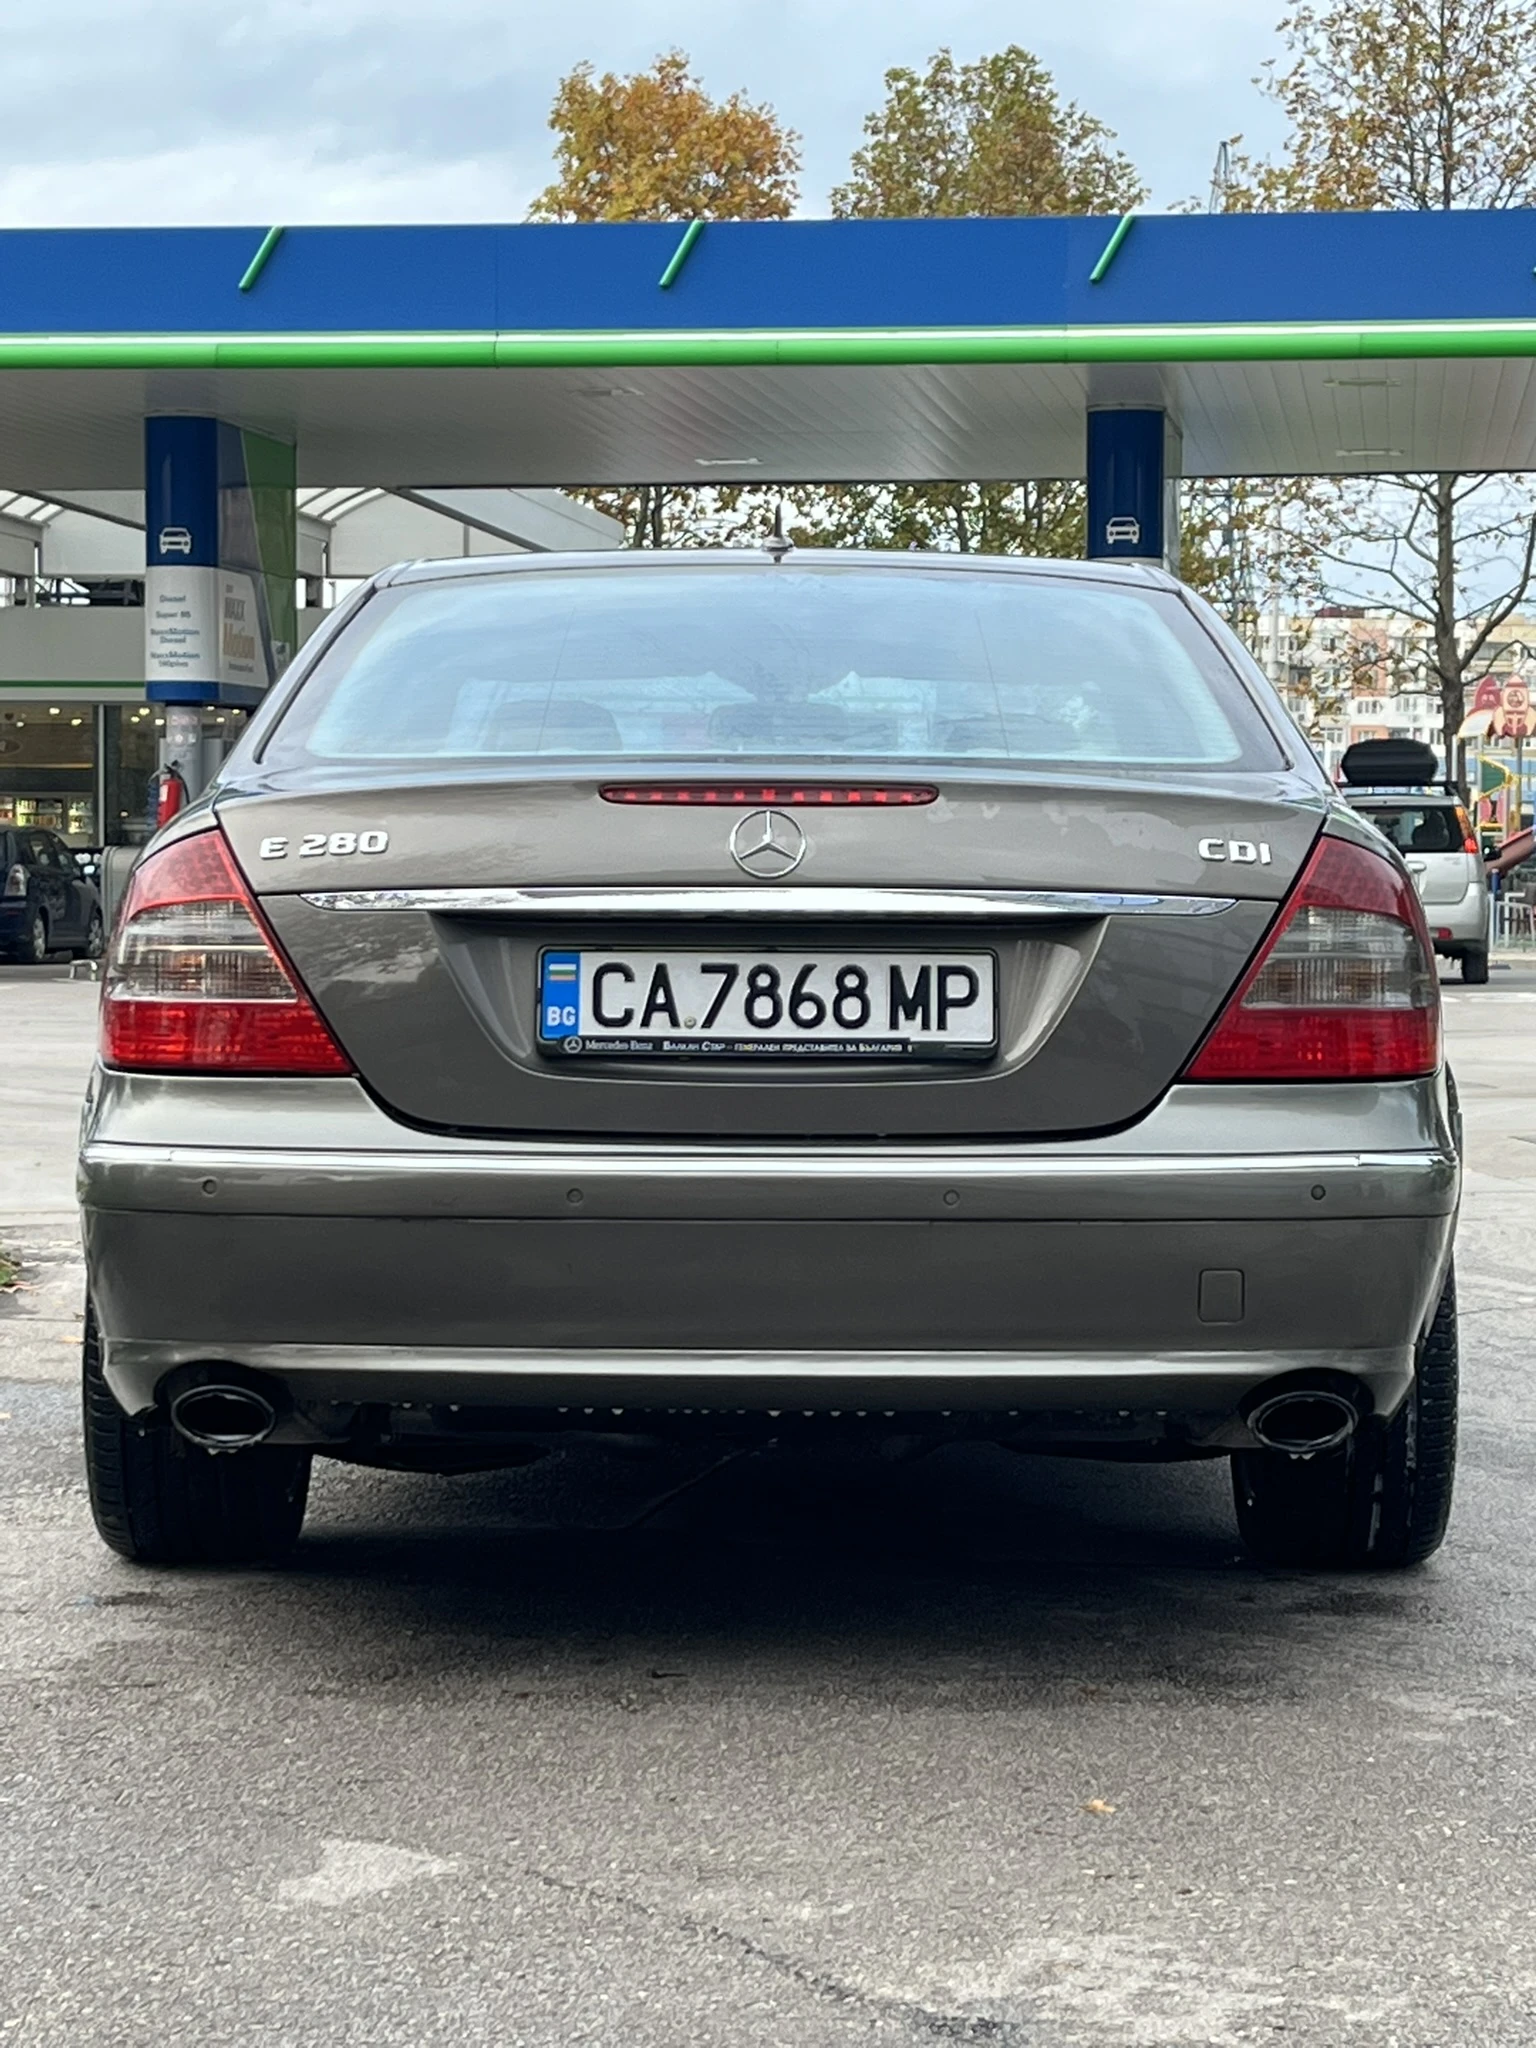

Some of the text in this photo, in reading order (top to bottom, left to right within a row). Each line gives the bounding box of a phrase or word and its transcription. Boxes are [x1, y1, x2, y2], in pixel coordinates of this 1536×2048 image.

[259, 831, 389, 860] E 280
[1198, 837, 1273, 865] CDI
[593, 962, 980, 1031] CA 7868 MP
[546, 1006, 576, 1027] BG
